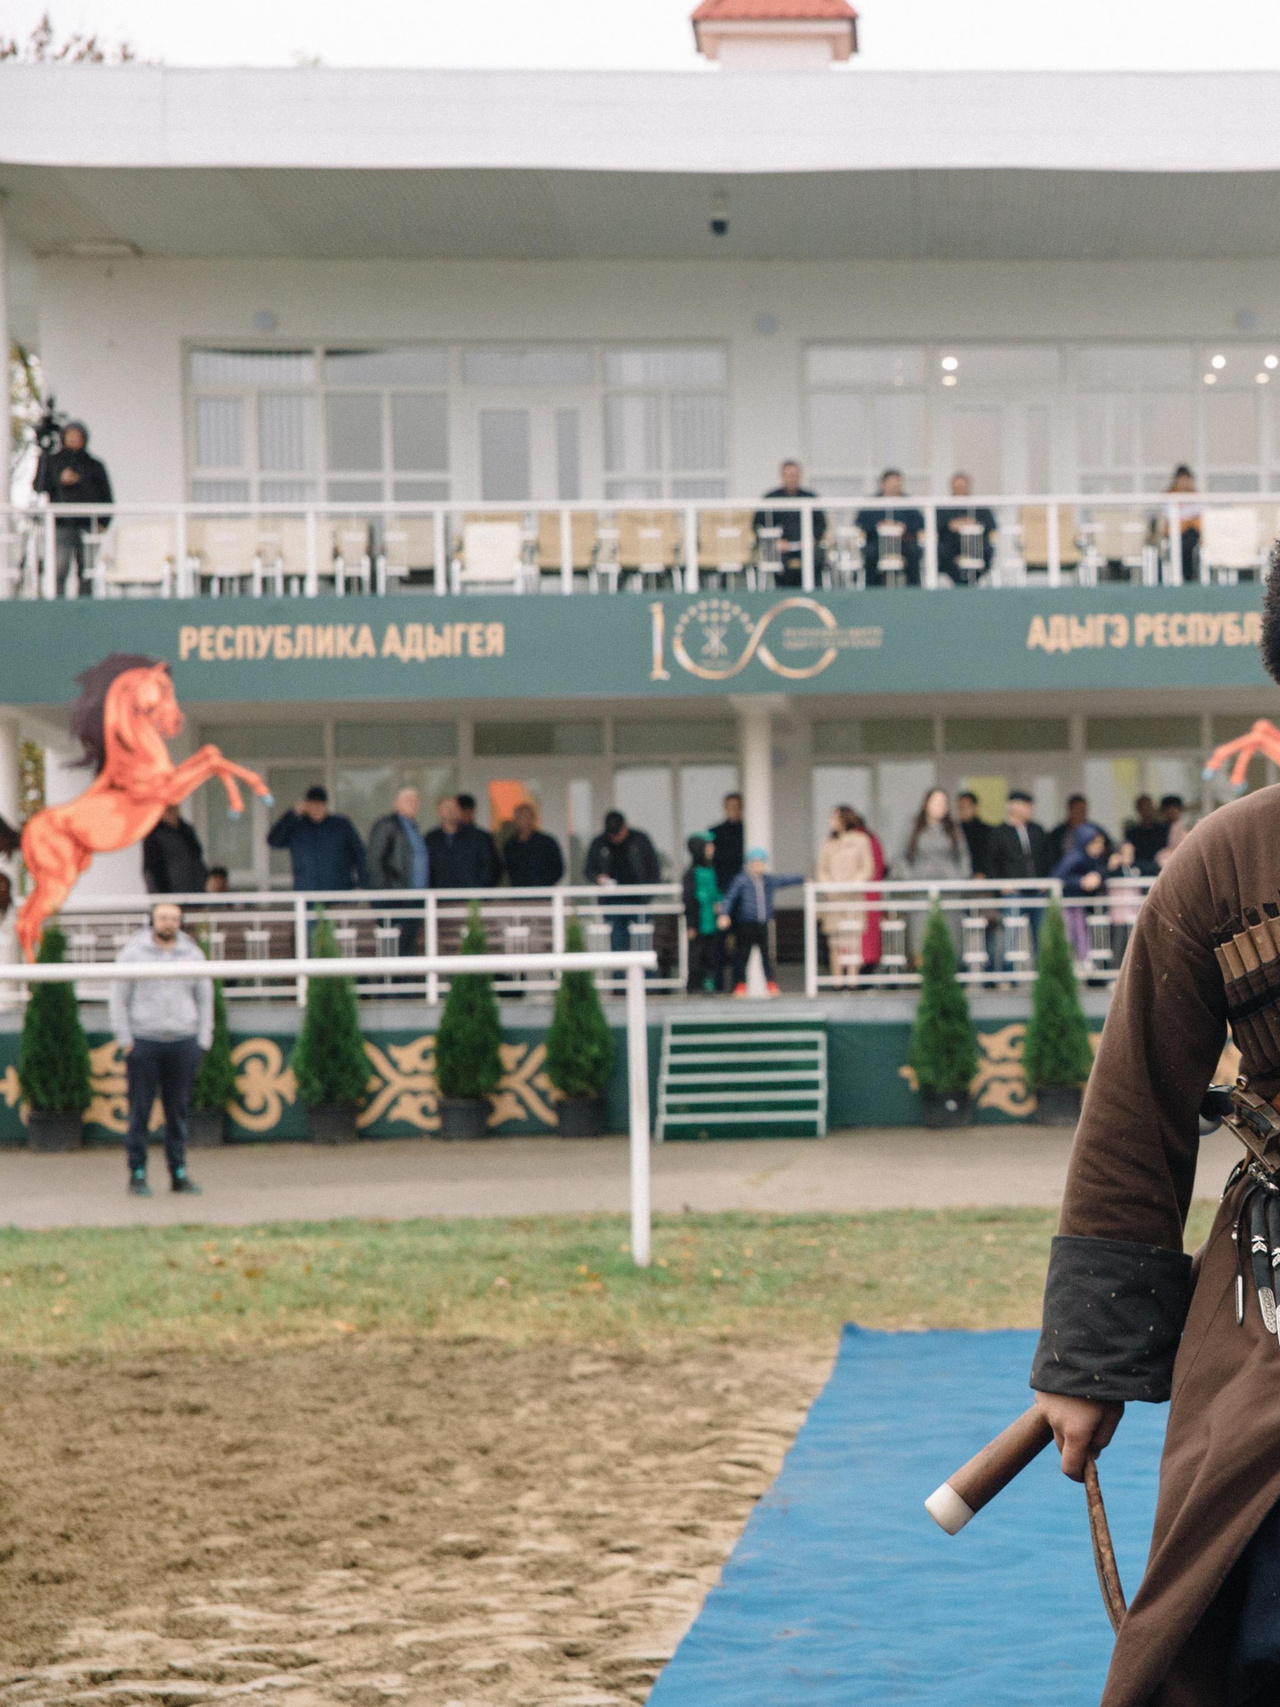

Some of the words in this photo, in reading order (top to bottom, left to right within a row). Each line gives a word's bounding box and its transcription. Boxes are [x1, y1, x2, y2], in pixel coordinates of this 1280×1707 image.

[179, 624, 376, 661] РЕСПУБЛИКА
[382, 622, 504, 663] АДЫГЕЯ
[1027, 614, 1129, 654] АДЫГЭ
[1134, 612, 1264, 648] РЕСПУБЛ
